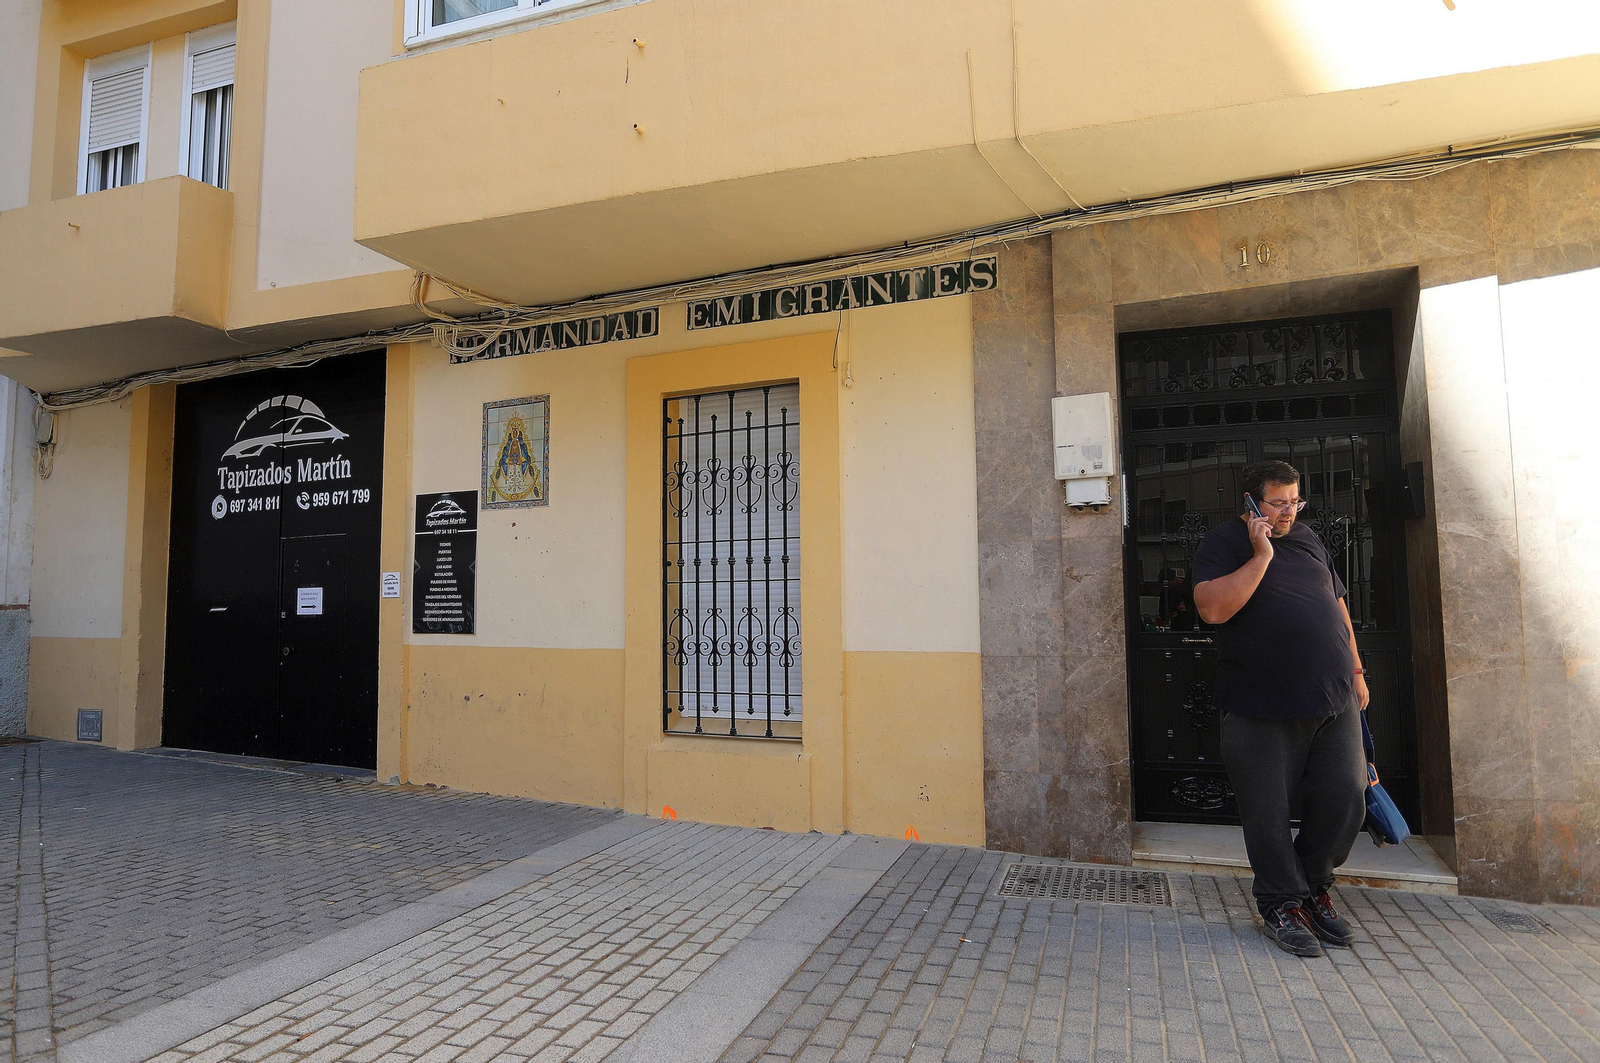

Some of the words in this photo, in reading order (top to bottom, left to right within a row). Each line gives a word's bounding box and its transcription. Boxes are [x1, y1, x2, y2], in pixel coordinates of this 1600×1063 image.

[1237, 243, 1271, 267] 10
[688, 258, 996, 330] EMIGRANTES
[217, 461, 292, 494] Tapizados
[297, 454, 352, 483] Martín
[230, 499, 245, 513] 697
[247, 497, 263, 512] 341
[265, 495, 280, 511] 811
[312, 492, 330, 507] 959
[332, 490, 349, 506] 671
[352, 488, 371, 504] 799
[426, 518, 449, 527] Tapizados
